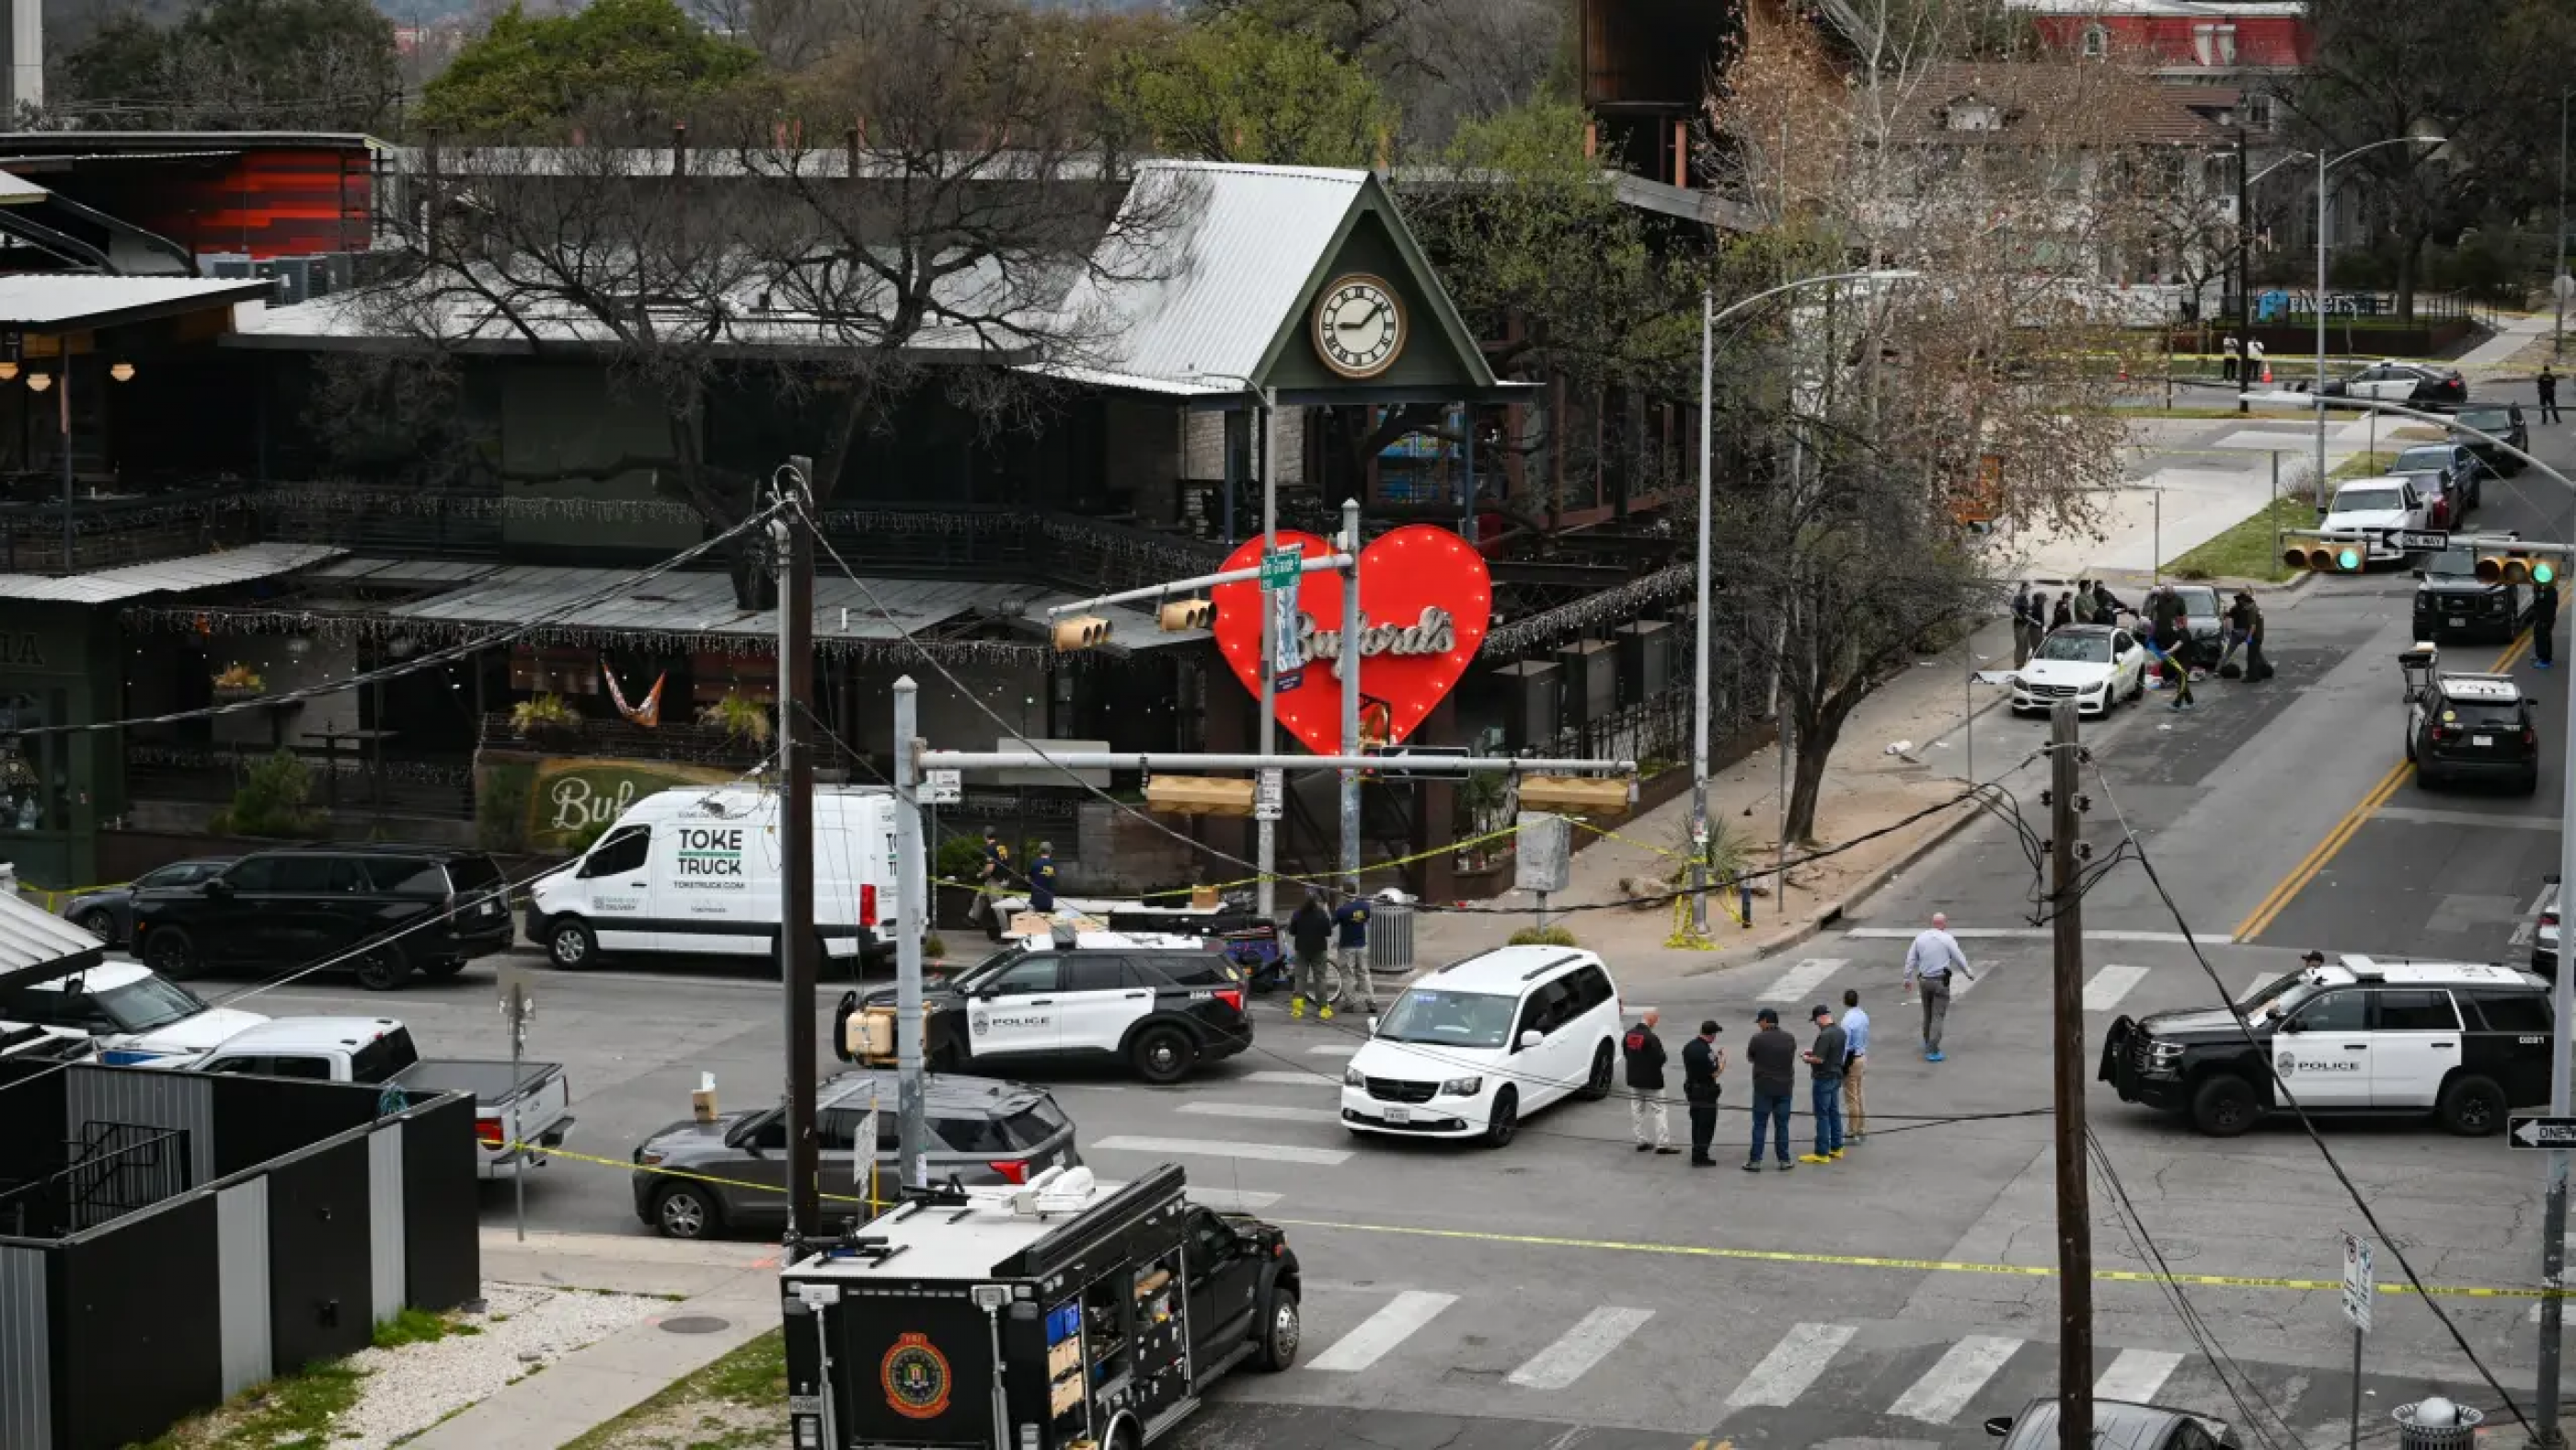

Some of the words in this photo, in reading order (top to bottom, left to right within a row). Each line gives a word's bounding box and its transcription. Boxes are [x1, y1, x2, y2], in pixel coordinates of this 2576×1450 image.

[2422, 535, 2443, 547] WAY
[678, 829, 742, 850] TOKE
[678, 857, 742, 875] TRUCK
[992, 1016, 1051, 1027] POLICE
[2298, 1061, 2361, 1072] POLICE
